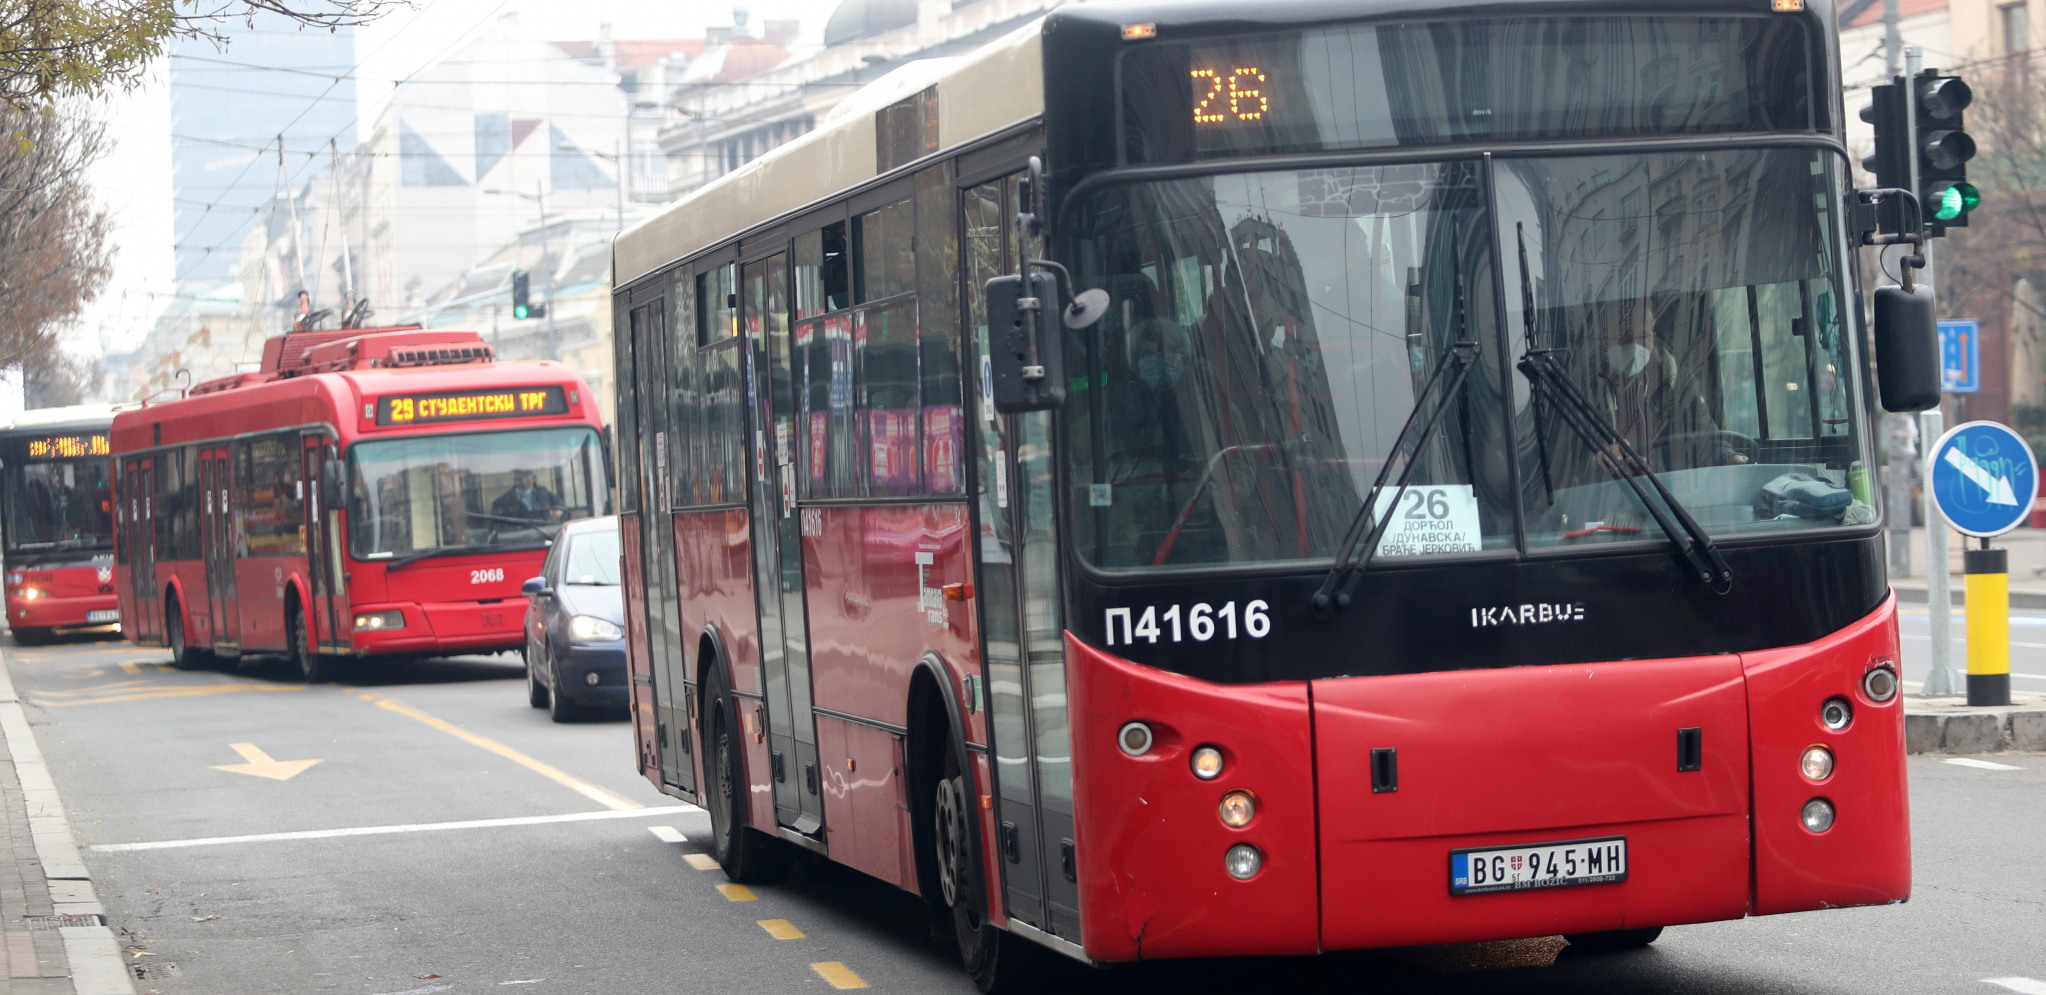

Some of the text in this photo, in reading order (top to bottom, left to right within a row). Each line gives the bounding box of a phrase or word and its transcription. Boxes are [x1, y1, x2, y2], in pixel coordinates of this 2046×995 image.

[1190, 67, 1268, 123] 26
[390, 392, 547, 421] 29 СТУДЕНТСКИ ТРГ
[1403, 489, 1450, 520] 26
[1403, 520, 1454, 532] ДОРЋОЛ
[470, 567, 505, 584] 2068
[1105, 599, 1271, 646] П41616
[1455, 877, 1468, 885] SRB
[1473, 855, 1505, 884] BG
[1514, 880, 1532, 889] BM
